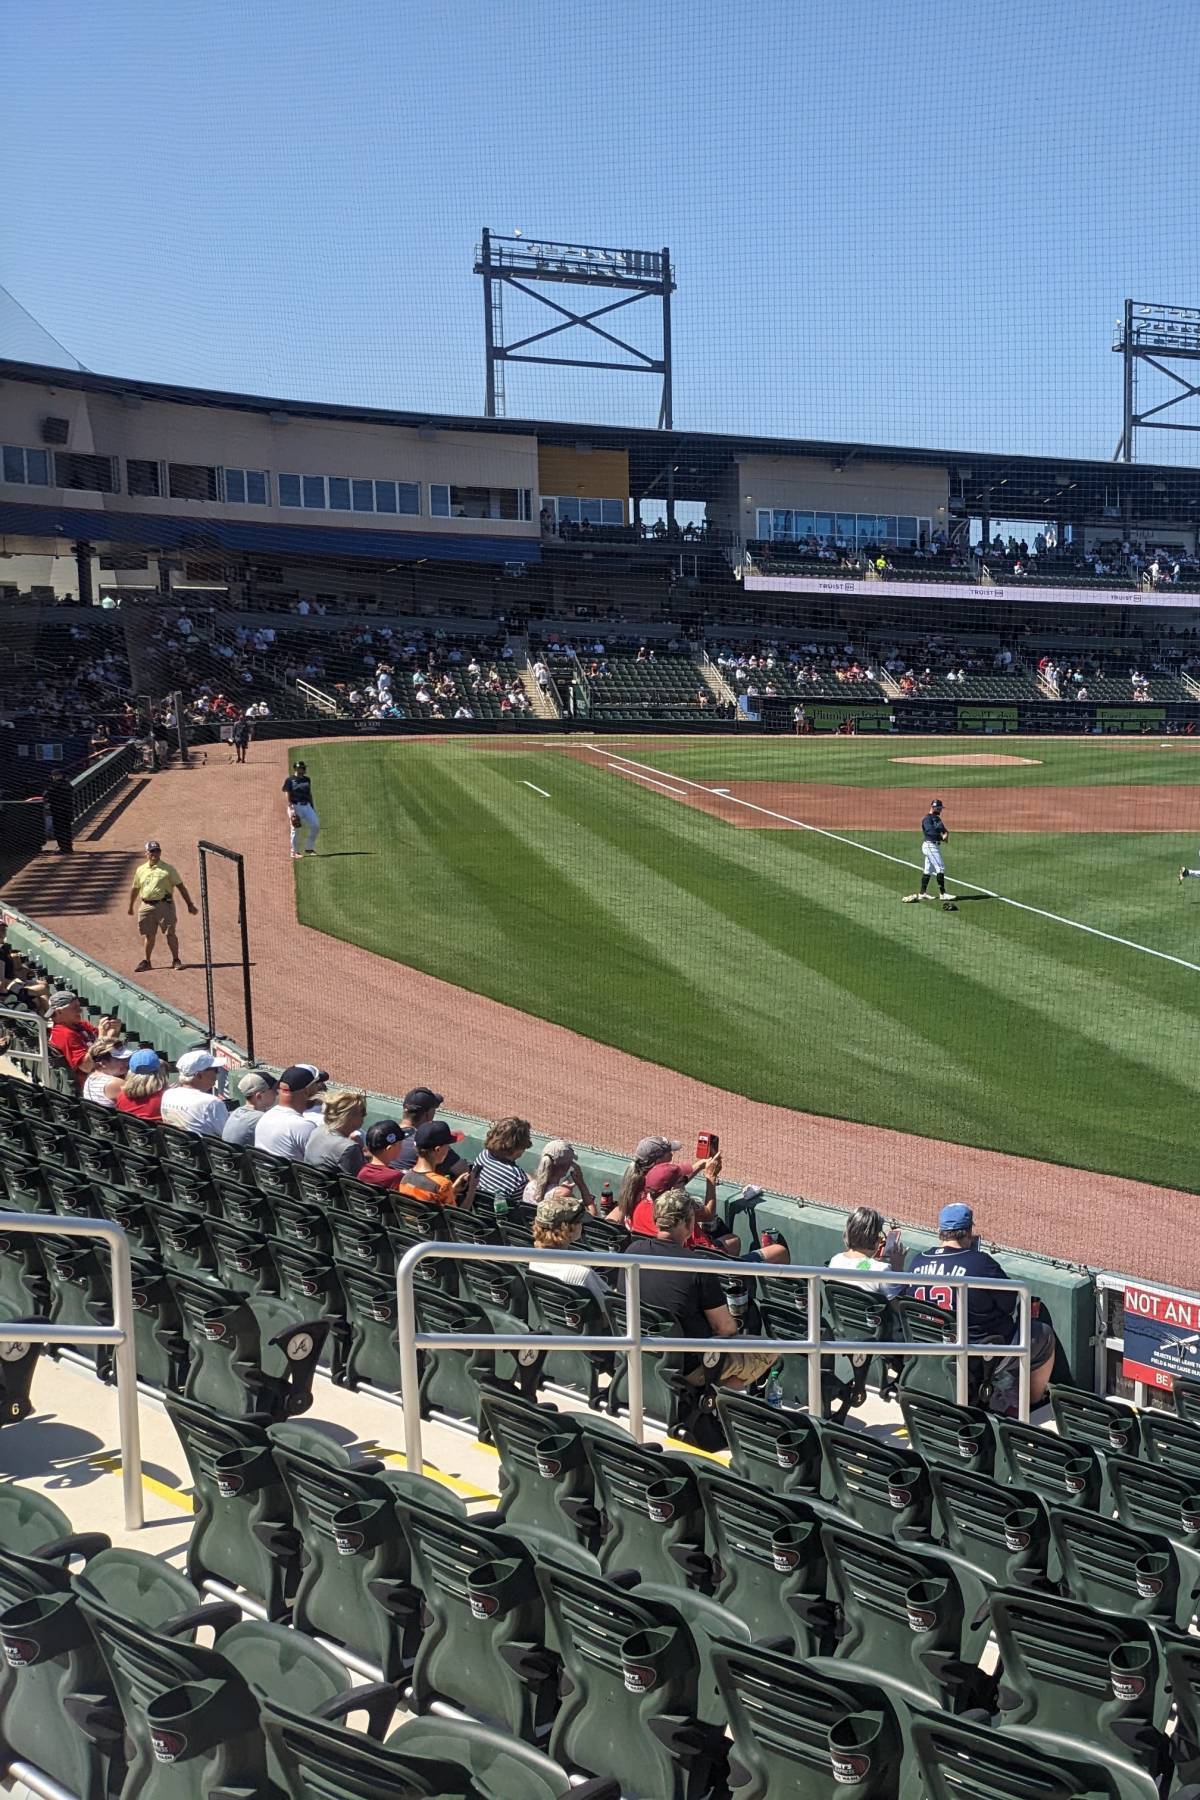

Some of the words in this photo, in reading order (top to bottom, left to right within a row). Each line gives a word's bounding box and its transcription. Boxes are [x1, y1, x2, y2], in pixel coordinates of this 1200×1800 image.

[1125, 1291, 1160, 1316] NOT
[1164, 1302, 1192, 1326] AN
[1154, 1350, 1172, 1360] OBJECTS
[1150, 1358, 1163, 1366] FIELD
[1156, 1373, 1168, 1384] BE
[708, 1398, 712, 1407] 3
[12, 1403, 20, 1415] 6
